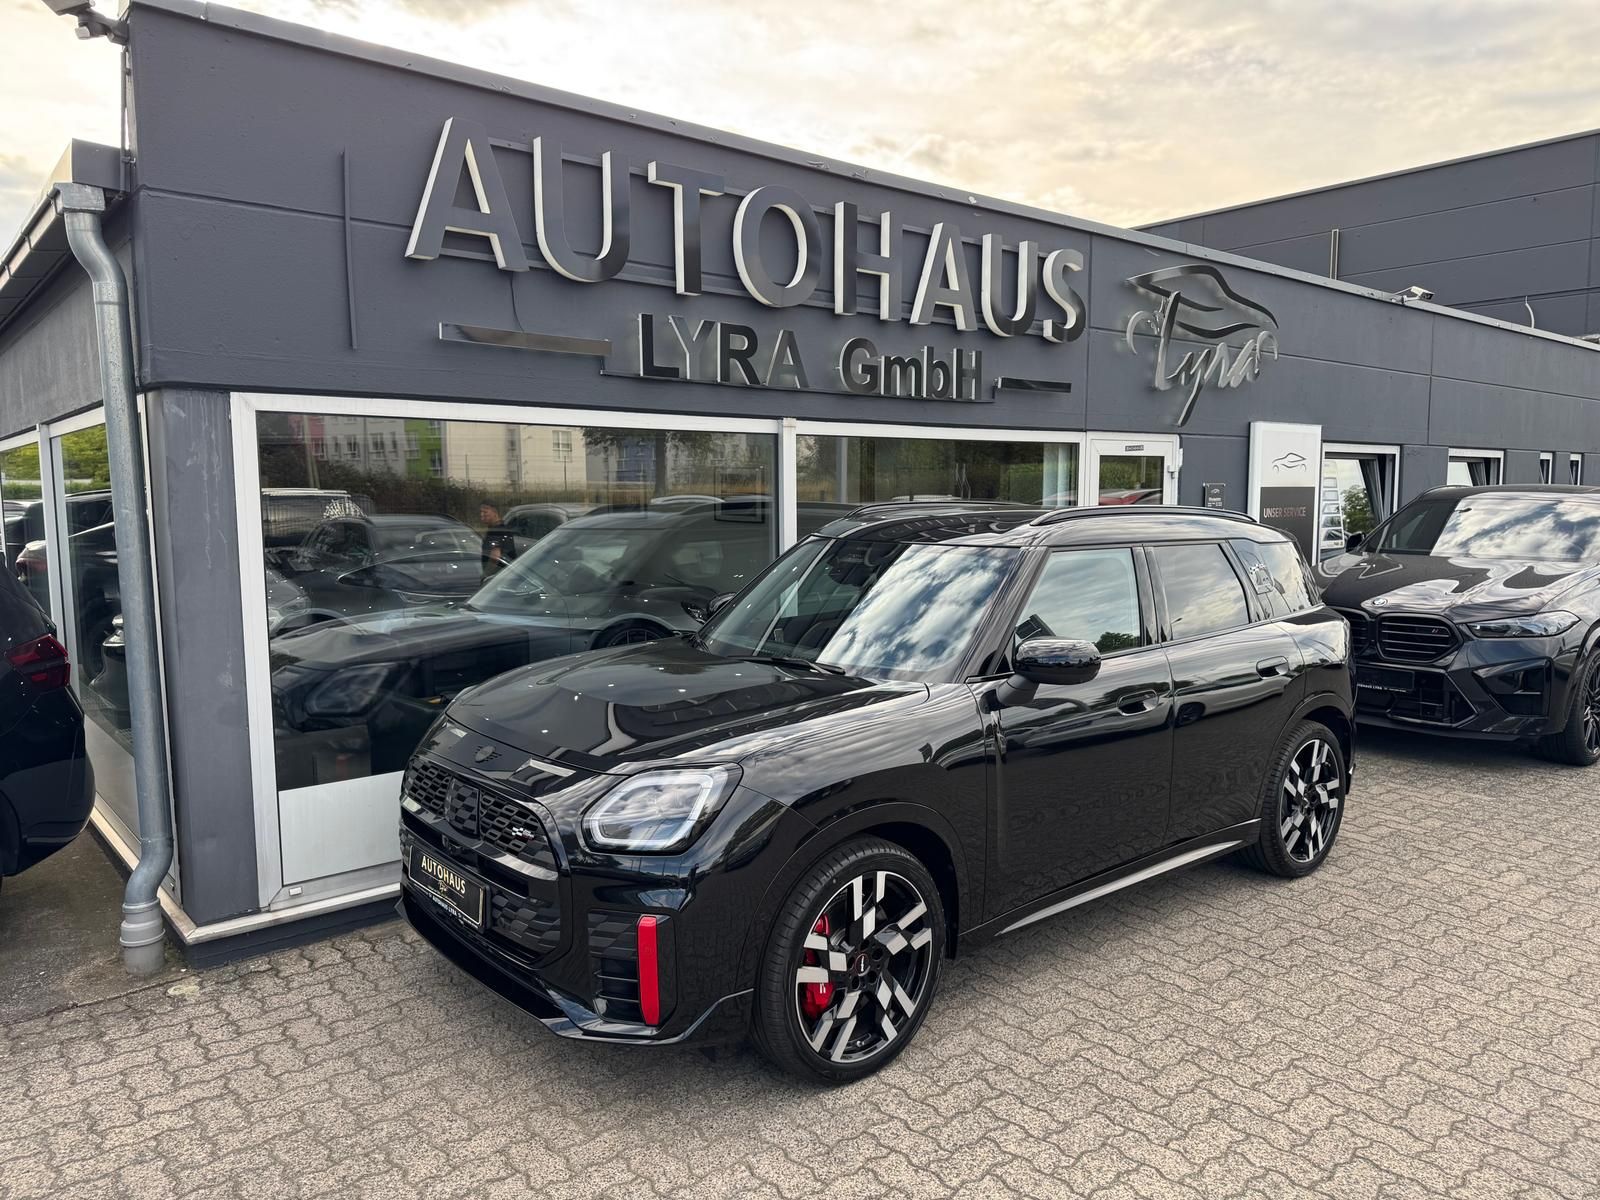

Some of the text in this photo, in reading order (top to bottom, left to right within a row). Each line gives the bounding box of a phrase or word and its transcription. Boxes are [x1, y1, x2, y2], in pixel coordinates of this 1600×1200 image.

[405, 116, 1086, 342] AUTOHAUS
[637, 312, 983, 401] LYRA GmbH
[1263, 505, 1306, 519] UNSER SERVICE
[421, 855, 466, 894] AUTOHAUS
